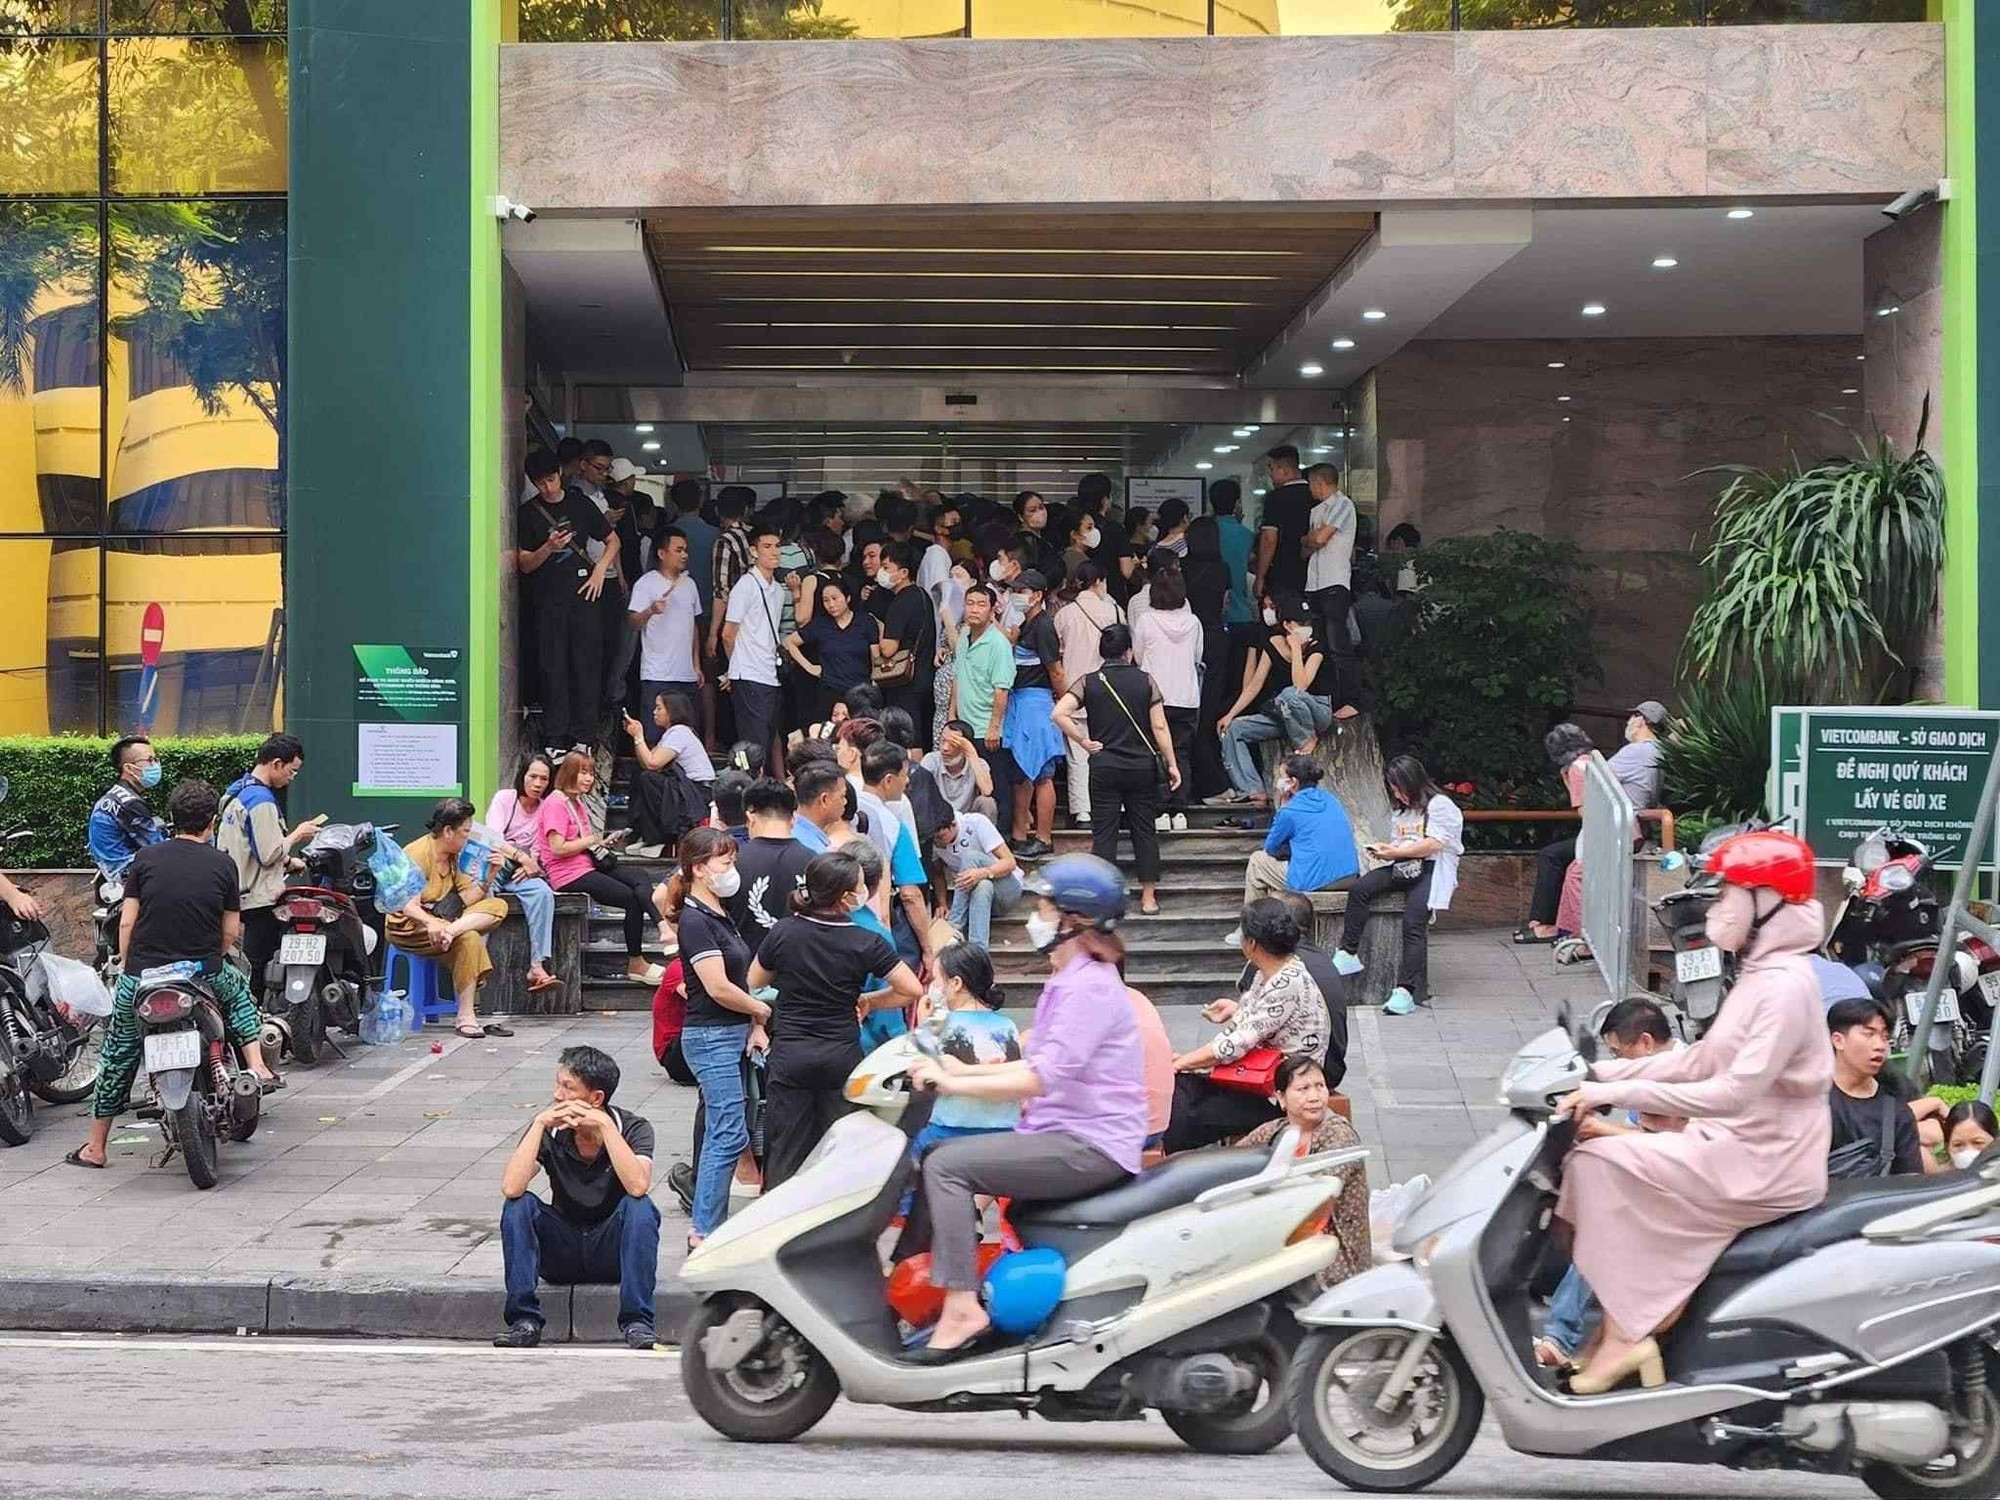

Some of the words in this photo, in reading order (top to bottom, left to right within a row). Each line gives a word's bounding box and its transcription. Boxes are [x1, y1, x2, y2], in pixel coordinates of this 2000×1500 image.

[1821, 729, 1900, 745] VIETCOMBANK
[1911, 727, 1927, 746] SỞ
[1928, 731, 1957, 746] GIAO
[1958, 732, 1986, 749] DỊCH
[1858, 763, 1889, 782] NGHỊ
[1892, 760, 1920, 782] QUÝ
[1923, 761, 1968, 781] KHÁCH
[1854, 787, 1880, 809] LẤY
[1883, 789, 1900, 809] VÉ
[1929, 794, 1947, 810] XE
